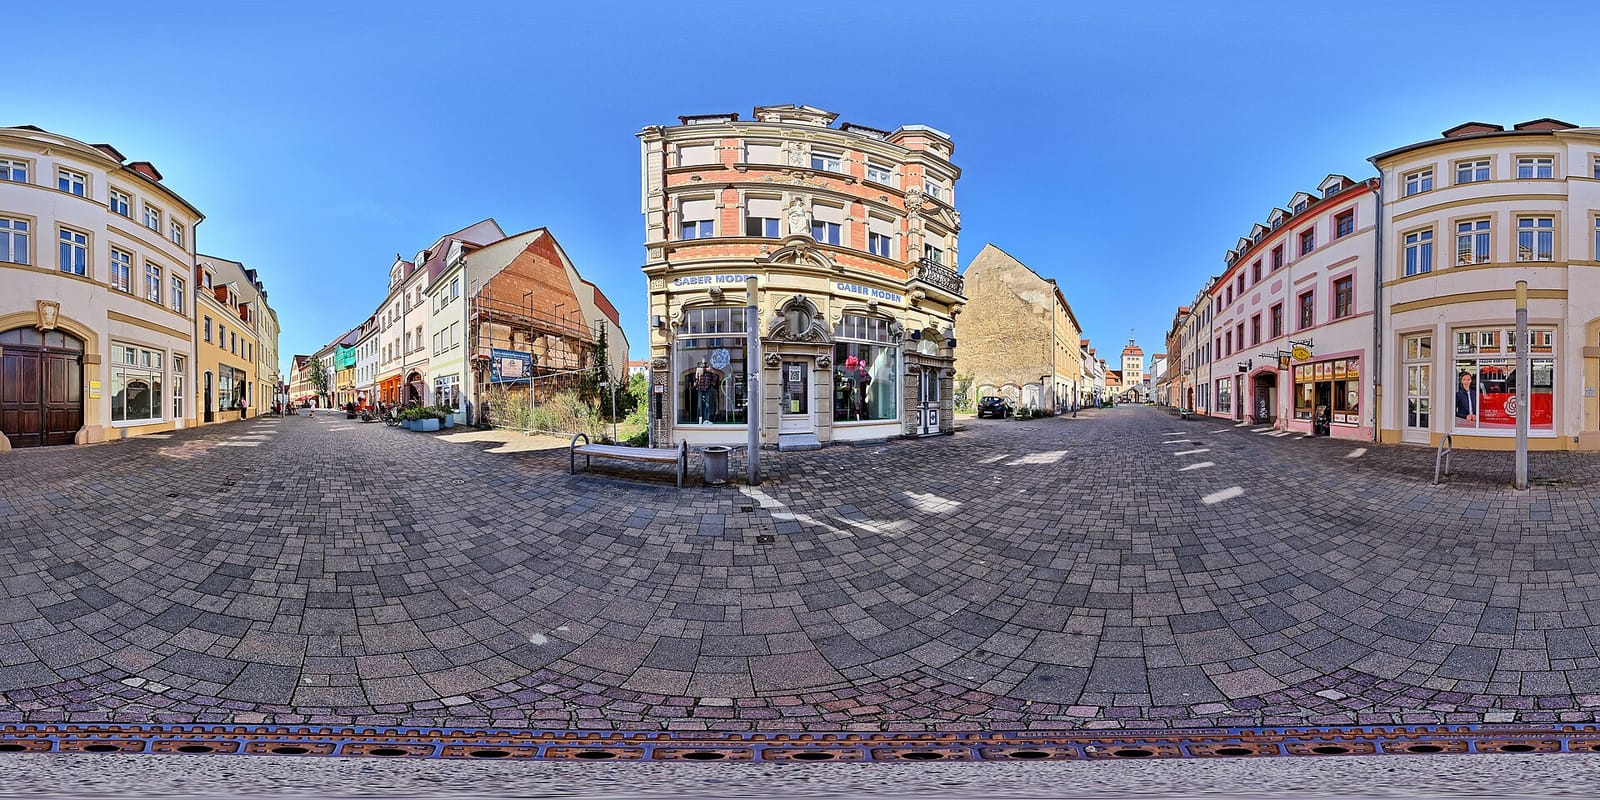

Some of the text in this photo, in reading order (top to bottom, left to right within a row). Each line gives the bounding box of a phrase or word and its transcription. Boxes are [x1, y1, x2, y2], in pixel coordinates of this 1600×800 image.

[673, 275, 712, 286] GABER
[836, 282, 901, 303] GABER MODEN
